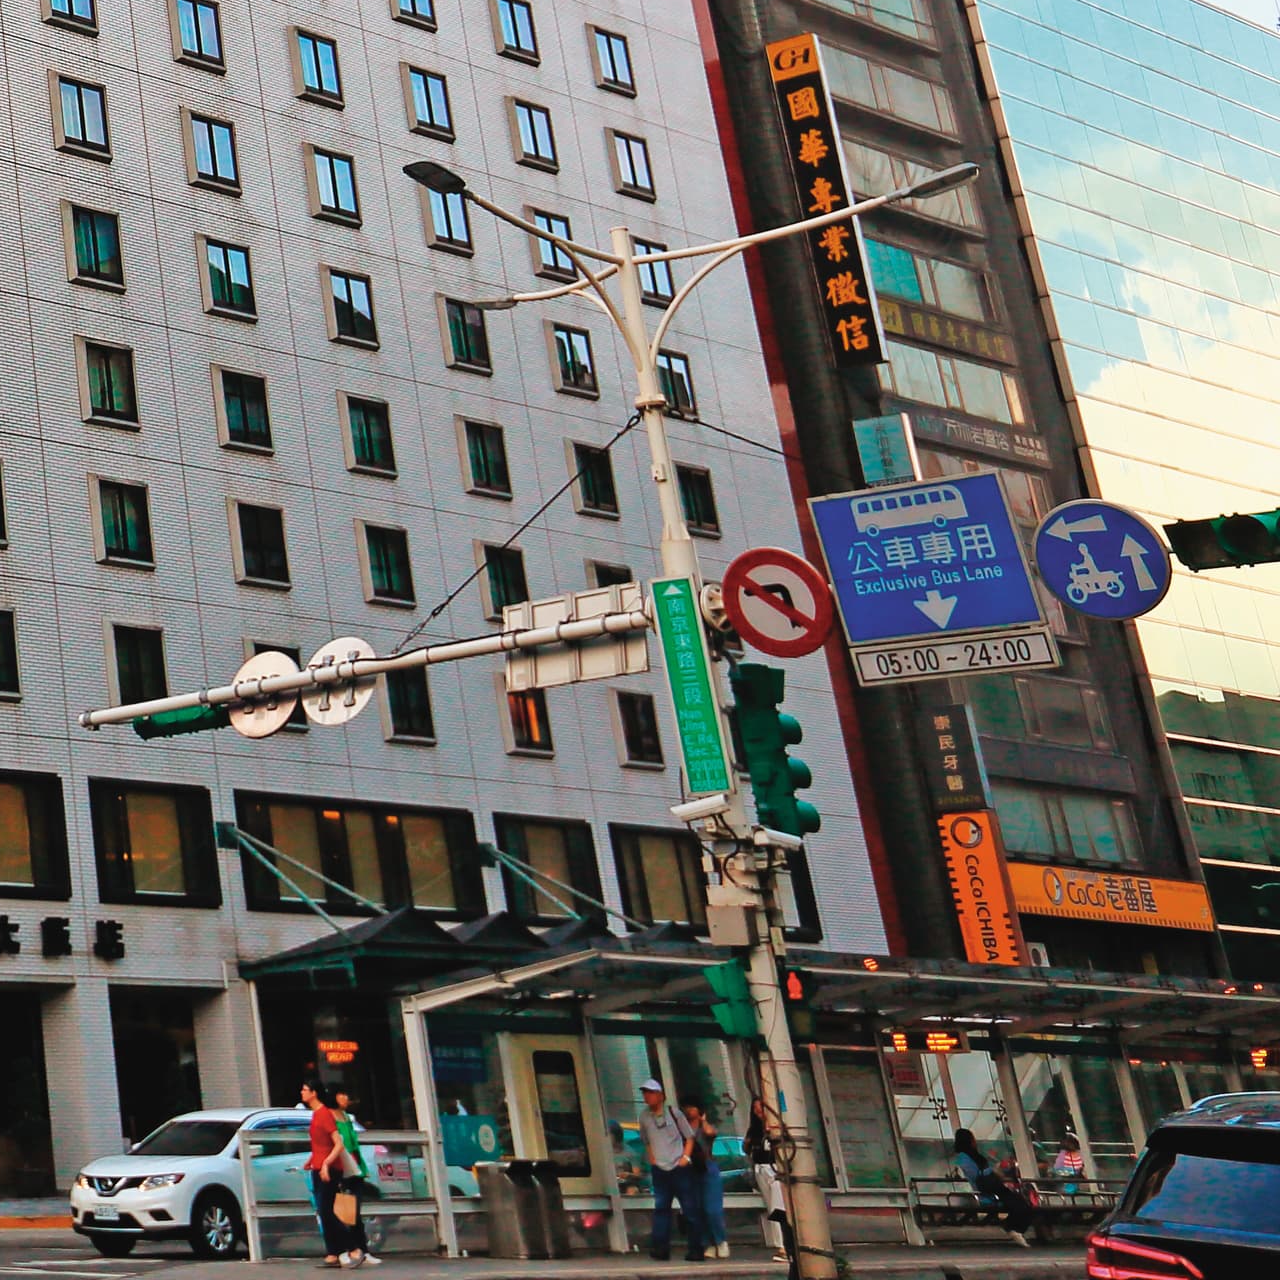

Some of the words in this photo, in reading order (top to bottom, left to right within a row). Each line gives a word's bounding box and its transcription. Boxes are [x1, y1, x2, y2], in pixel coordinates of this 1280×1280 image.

[847, 523, 997, 576] 公車專用
[854, 575, 928, 596] Exclusive
[931, 569, 961, 586] Bus
[964, 565, 1003, 581] Lane
[666, 598, 704, 705] 南京東路三段
[876, 647, 940, 676] 05:00
[964, 638, 1032, 667] 24:00
[974, 901, 1000, 962] ICHIBA
